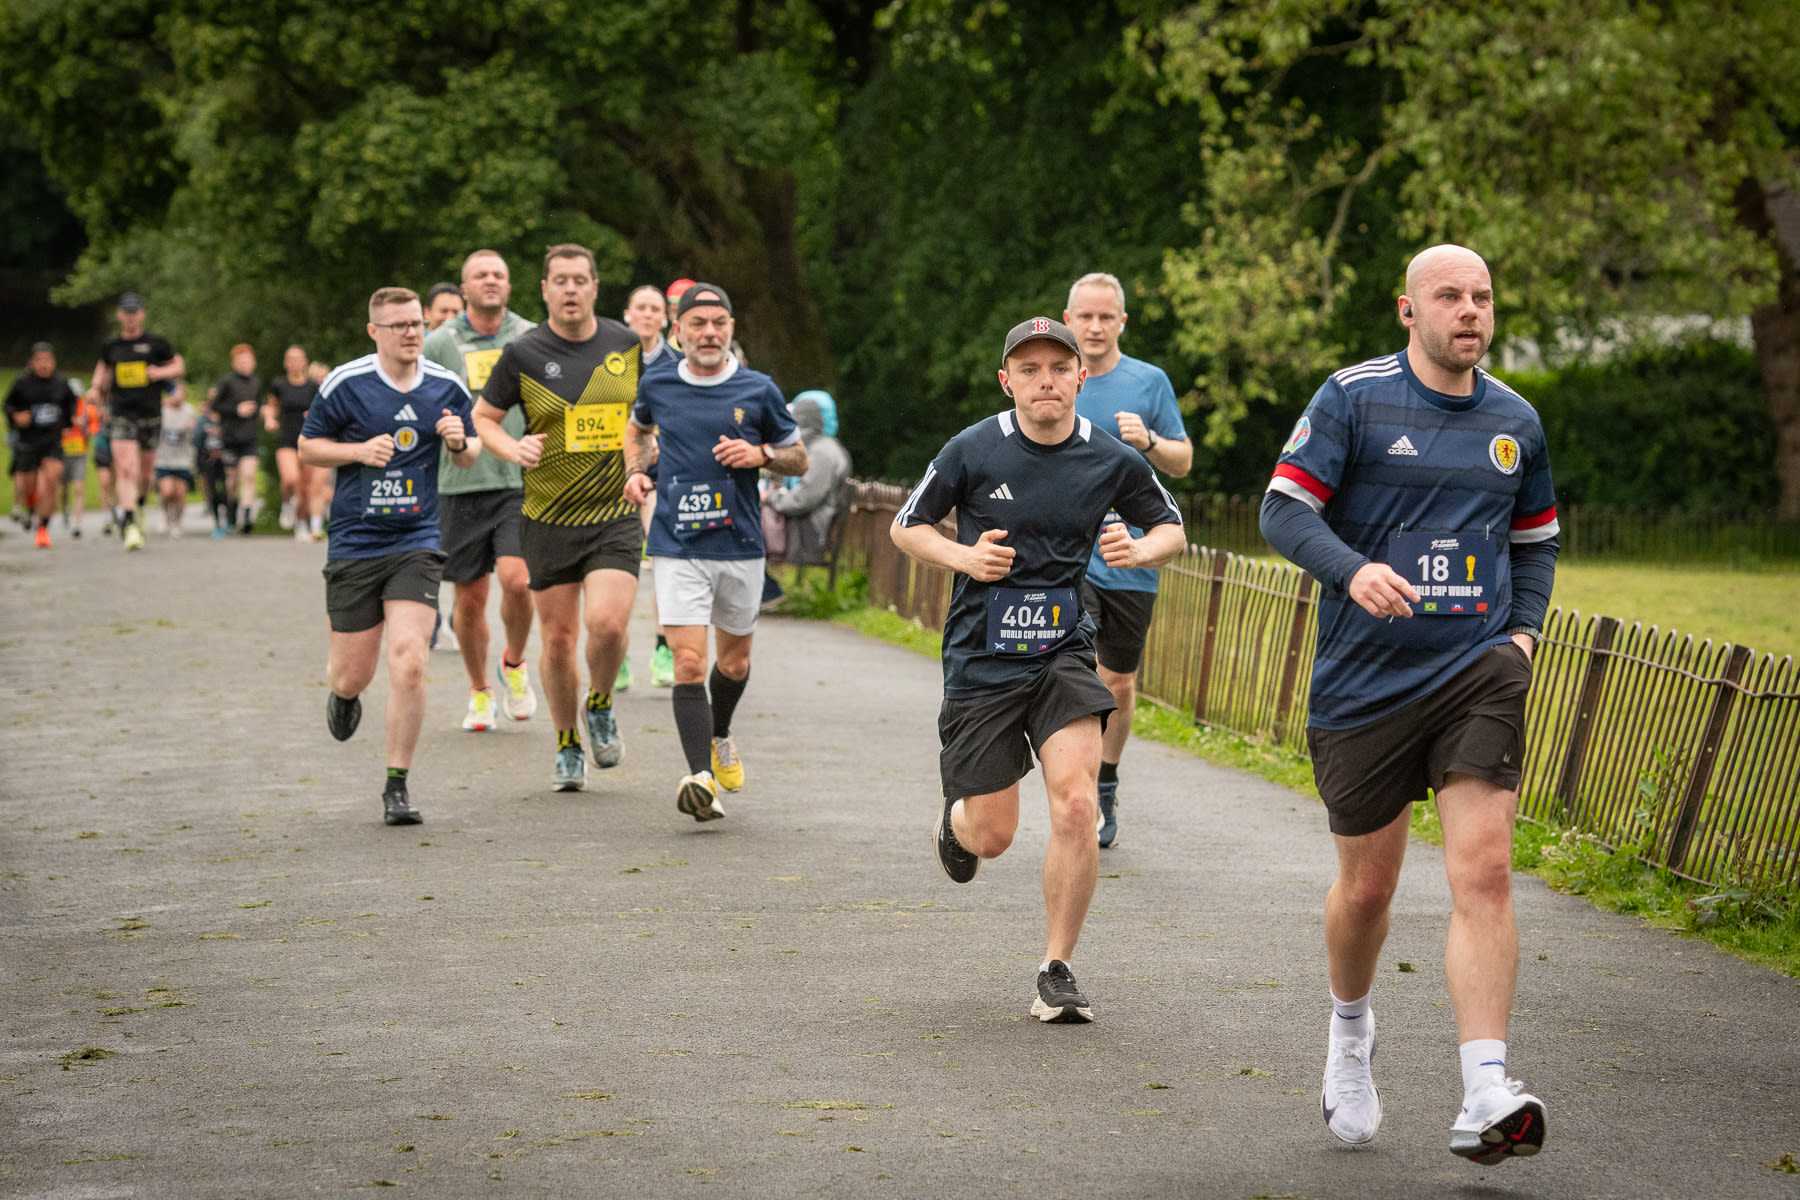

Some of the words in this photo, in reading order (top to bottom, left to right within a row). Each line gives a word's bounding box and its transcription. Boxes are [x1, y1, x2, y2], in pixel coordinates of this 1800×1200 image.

[1032, 319, 1050, 334] B
[576, 417, 605, 432] 894
[1388, 447, 1418, 456] adidas
[371, 479, 403, 497] 296
[678, 493, 711, 512] 439
[1417, 554, 1449, 582] 18
[1431, 585, 1447, 597] CUP
[1001, 605, 1047, 628] 404
[1000, 629, 1022, 639] WORLD
[1023, 630, 1036, 639] CUP
